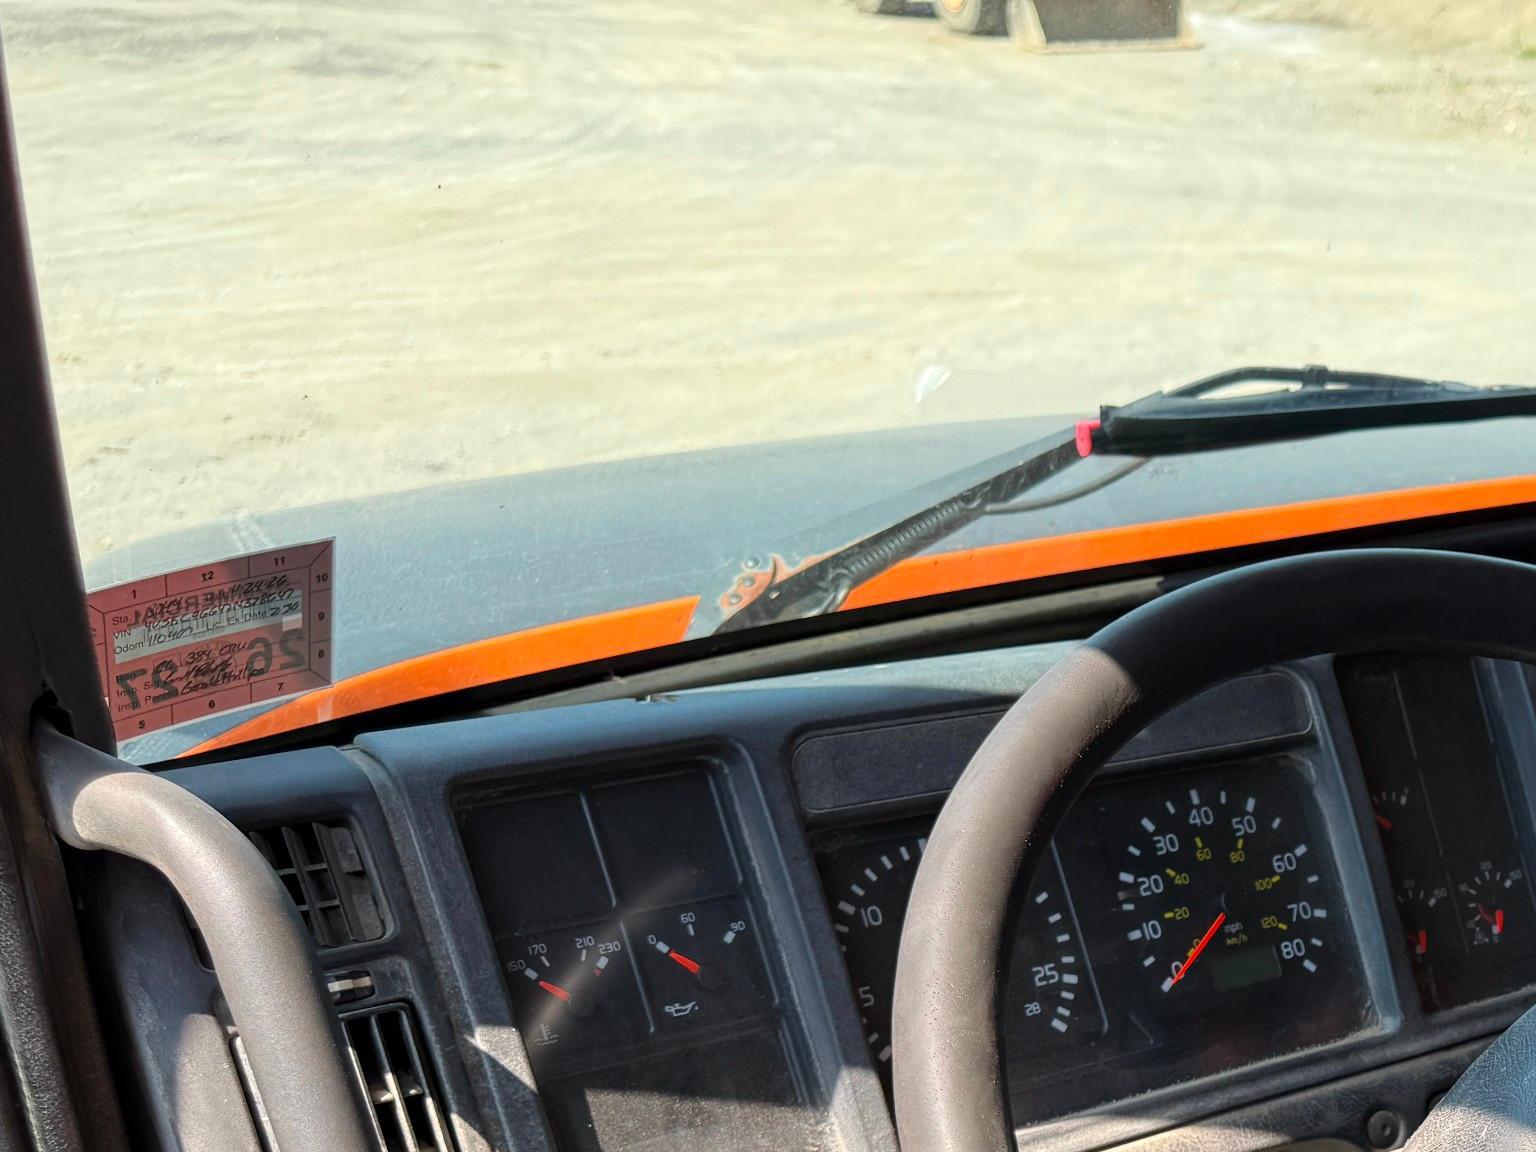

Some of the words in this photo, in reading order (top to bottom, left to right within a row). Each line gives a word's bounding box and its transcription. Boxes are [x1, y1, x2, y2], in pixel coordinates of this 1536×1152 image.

[1188, 806, 1214, 827] 40
[1231, 815, 1257, 837] 50
[1153, 833, 1179, 856] 30
[1196, 848, 1212, 861] 60
[1230, 850, 1246, 863] 80
[1272, 852, 1297, 873] 60
[1137, 874, 1164, 897] 20
[1173, 873, 1190, 886] 40
[1254, 878, 1273, 891] 100
[680, 912, 695, 923] 60
[860, 906, 883, 928] 10
[1174, 906, 1190, 920] 20
[1287, 901, 1312, 923] 70
[731, 920, 745, 932] 90
[1142, 920, 1162, 940] 10
[1260, 915, 1278, 929] 120
[528, 943, 547, 956] 170
[575, 936, 594, 949] 210
[598, 941, 621, 954] 230
[1280, 938, 1306, 960] 80
[1032, 963, 1059, 987] 25
[858, 986, 875, 1007] 5
[1024, 1001, 1041, 1017] 28
